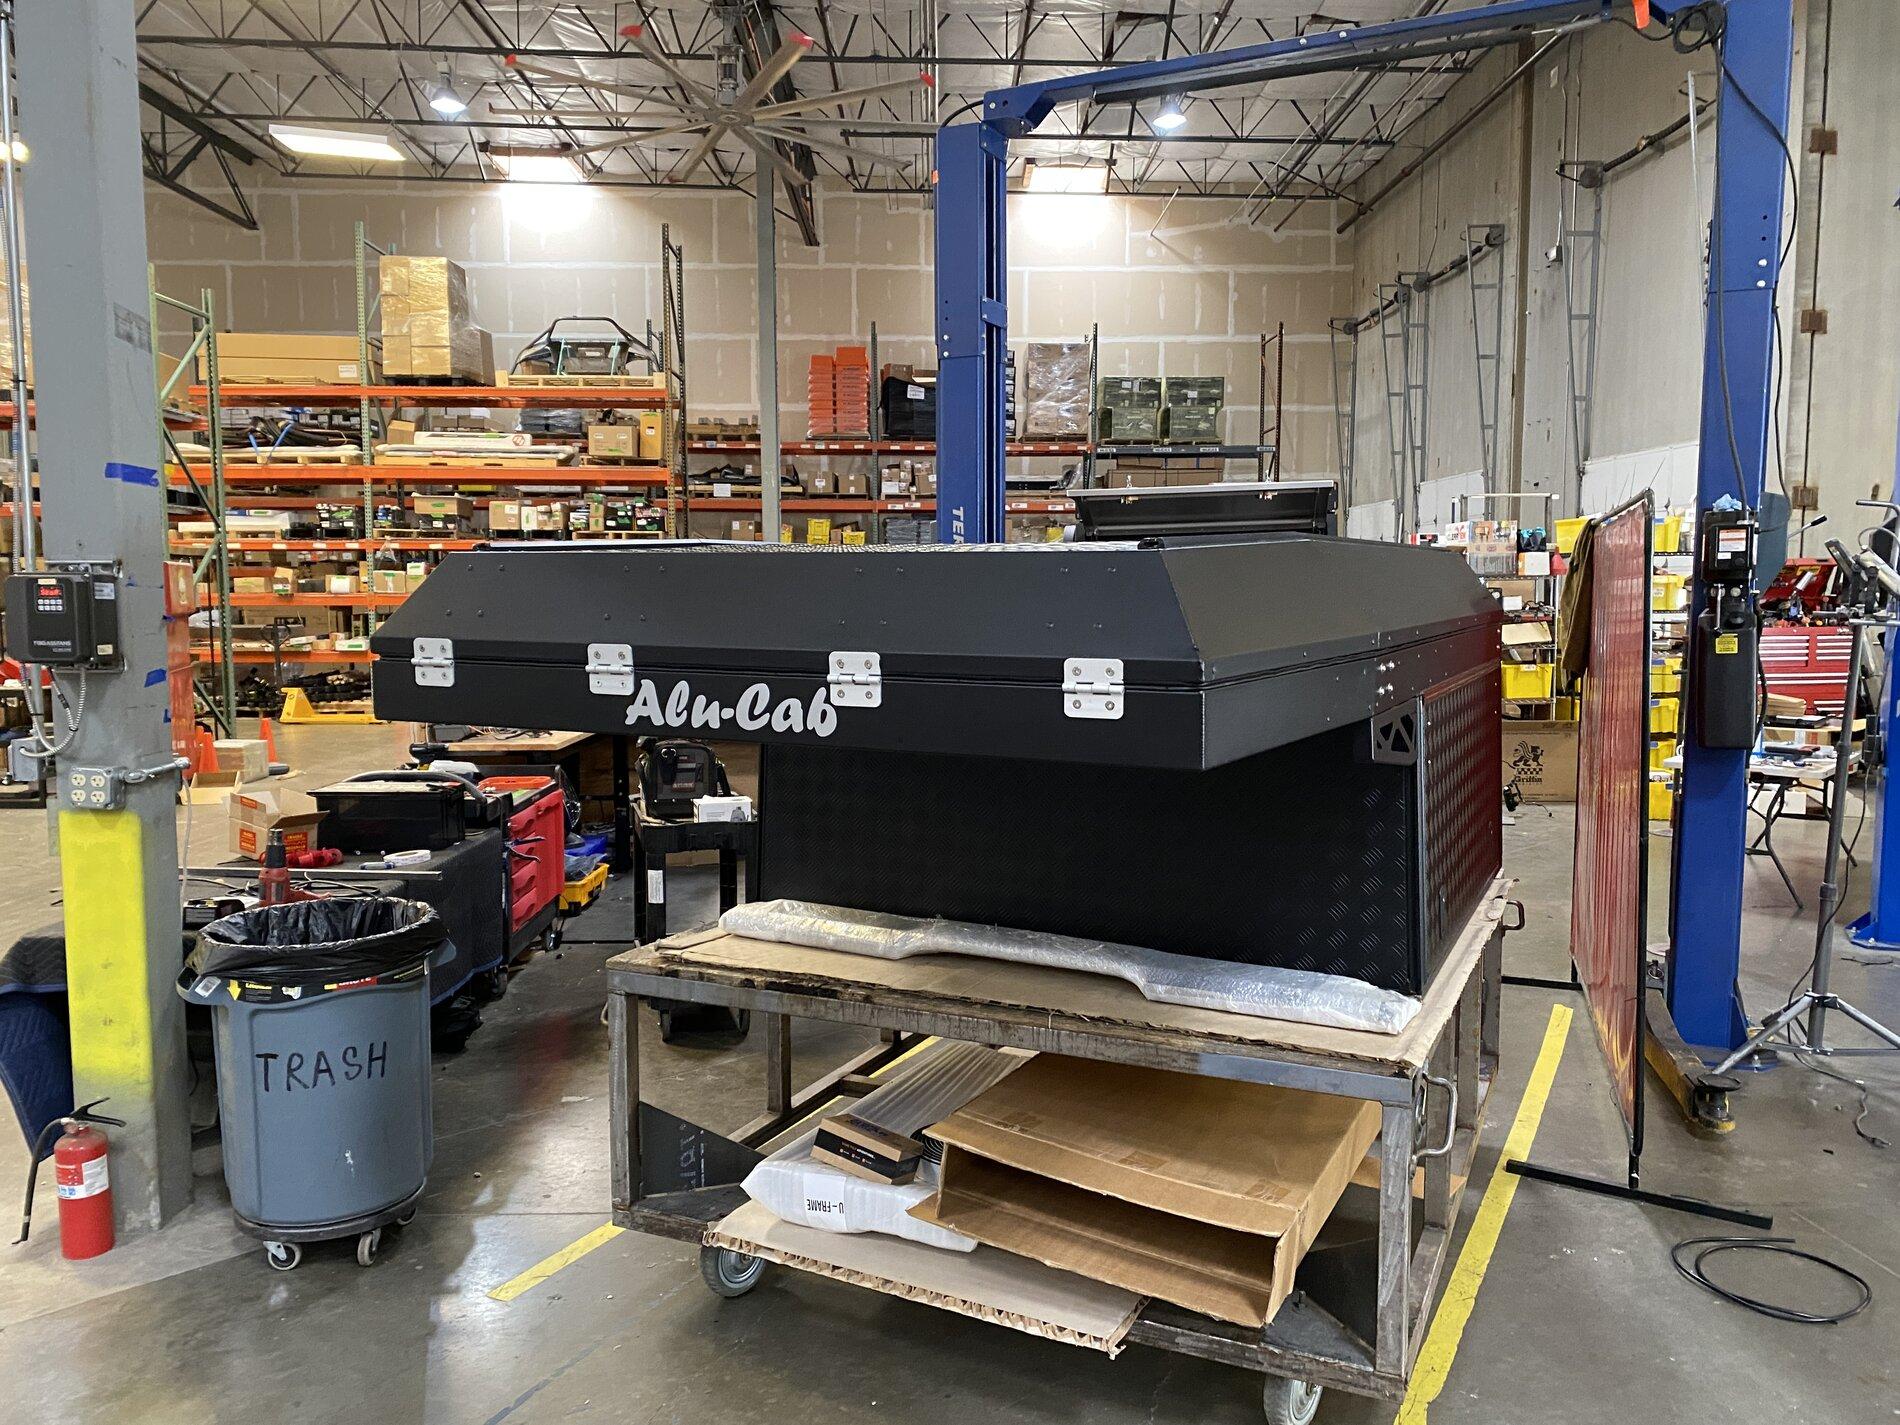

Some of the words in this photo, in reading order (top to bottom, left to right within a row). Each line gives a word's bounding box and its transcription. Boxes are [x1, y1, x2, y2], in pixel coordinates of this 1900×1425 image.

[624, 679, 838, 738] Alu-Cab
[255, 1041, 387, 1092] TRASH
[806, 1198, 845, 1215] U-FRAME
